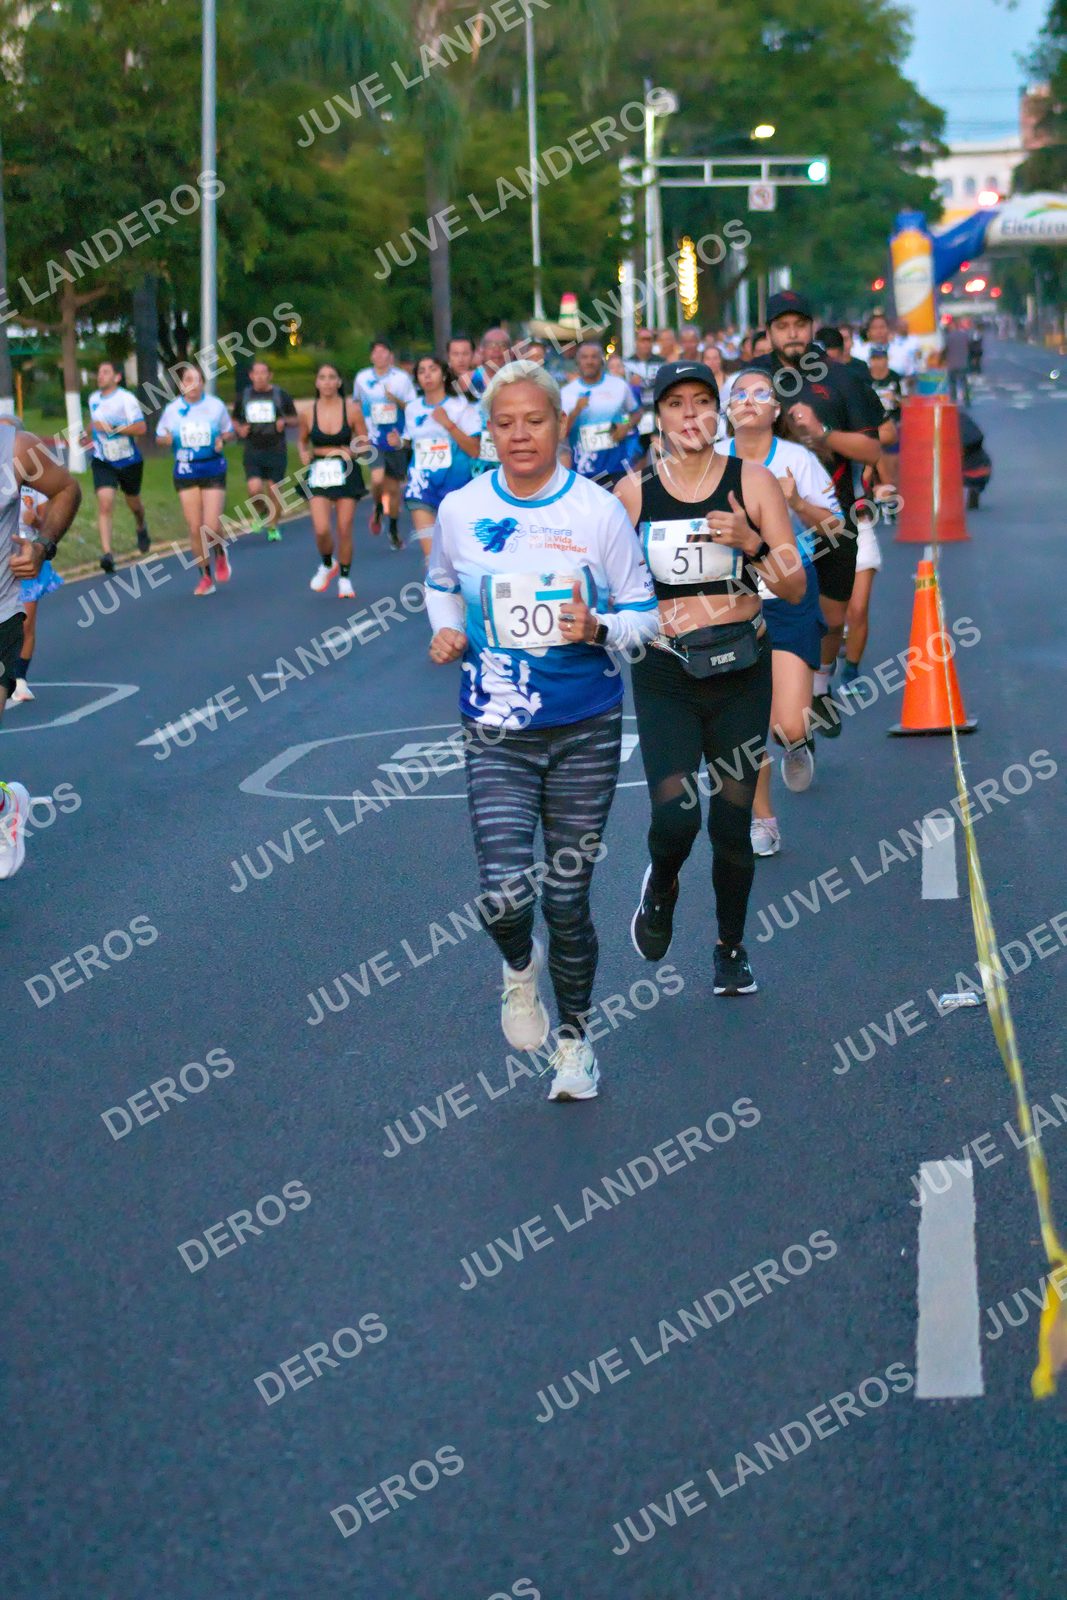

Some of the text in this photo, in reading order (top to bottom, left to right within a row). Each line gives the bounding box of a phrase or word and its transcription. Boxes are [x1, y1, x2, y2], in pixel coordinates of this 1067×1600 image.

[420, 450, 446, 465] 779
[553, 536, 573, 544] Vida
[544, 543, 587, 554] Integridad
[671, 546, 703, 575] 51
[510, 603, 567, 638] 30
[710, 651, 737, 667] PINK
